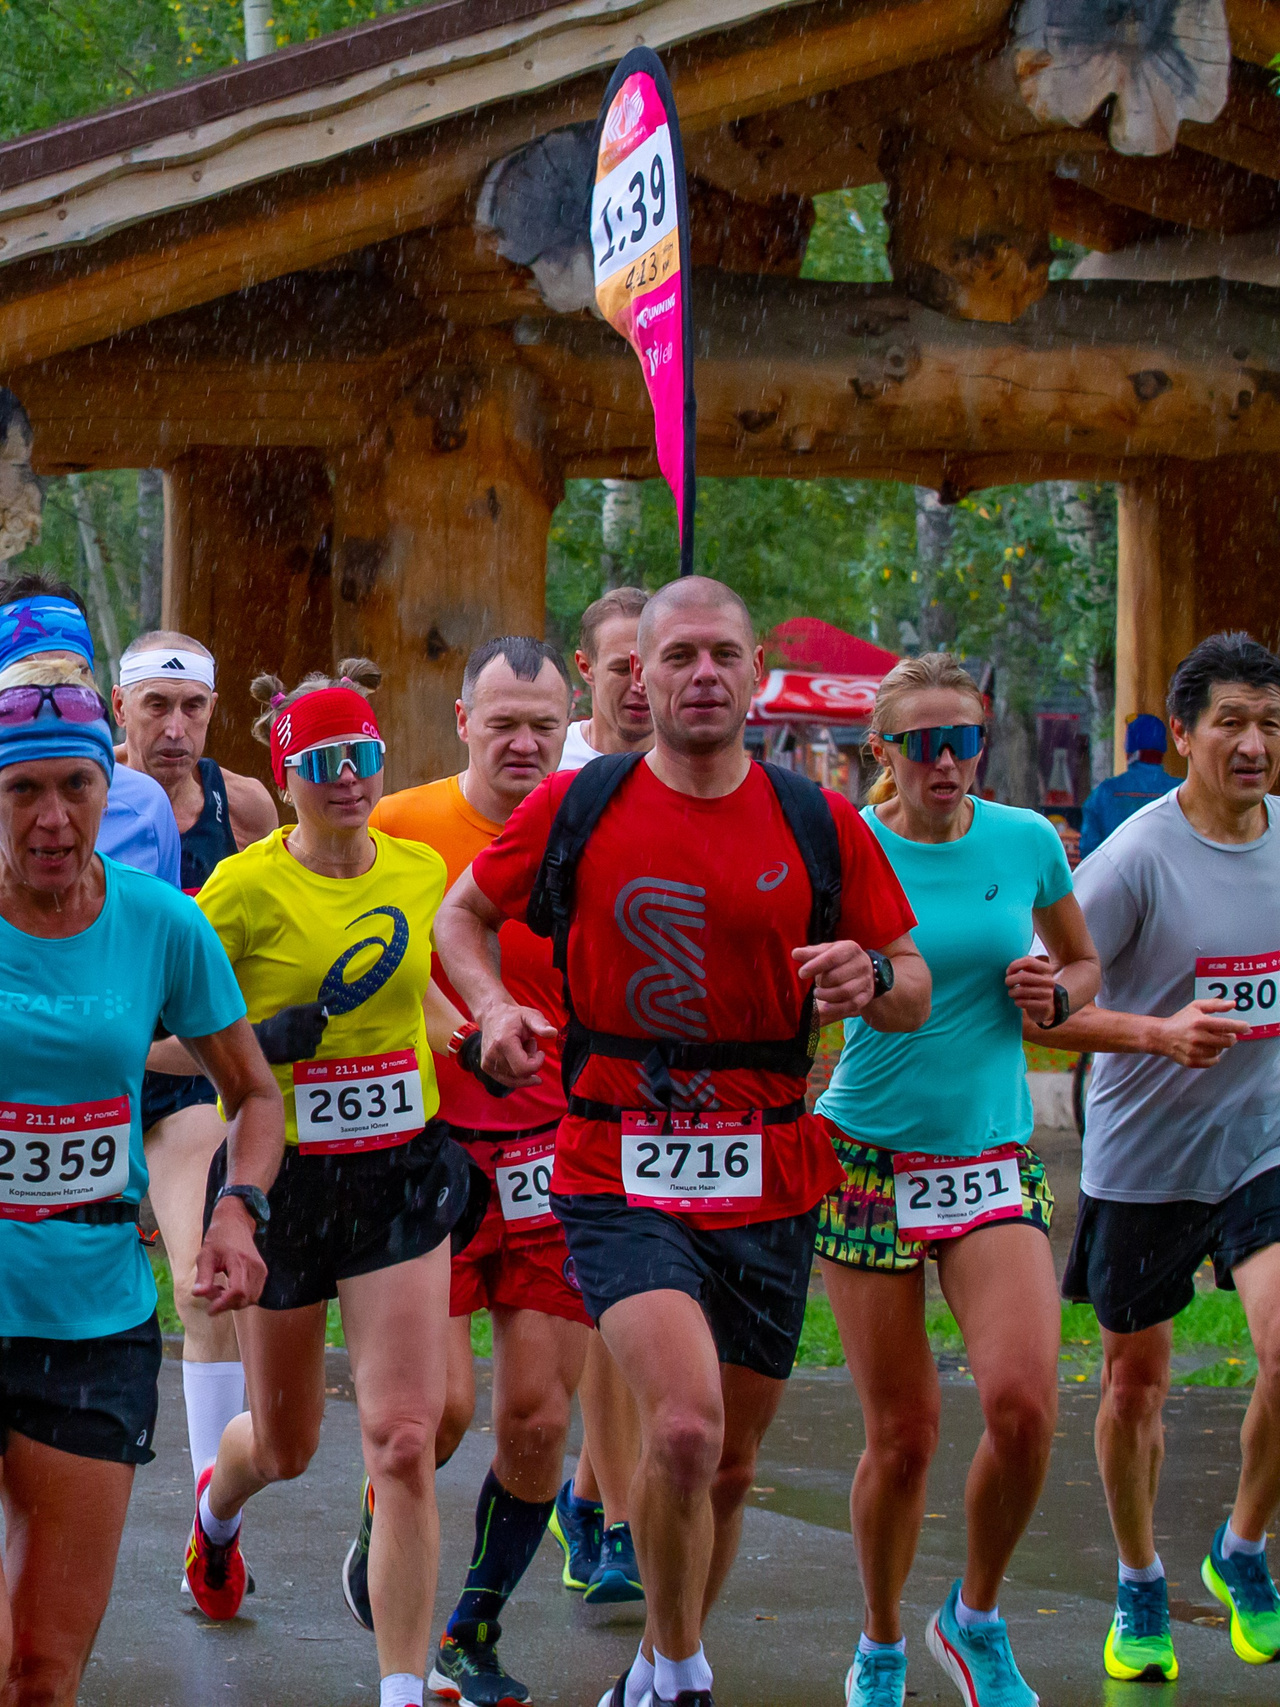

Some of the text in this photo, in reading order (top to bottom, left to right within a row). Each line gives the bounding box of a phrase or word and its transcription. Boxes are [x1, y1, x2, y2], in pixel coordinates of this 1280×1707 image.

[599, 153, 665, 267] 1:39
[1233, 961, 1254, 971] 21.1
[335, 1063, 359, 1076] 21.1
[309, 1079, 413, 1124] 2631
[25, 1113, 56, 1126] 21.1
[93, 1109, 120, 1120] ПОЛЮС
[527, 1144, 543, 1157] 21.1
[636, 1141, 749, 1179] 2716
[8, 1186, 94, 1197] Корнилович Наталья
[907, 1168, 1010, 1210] 2351
